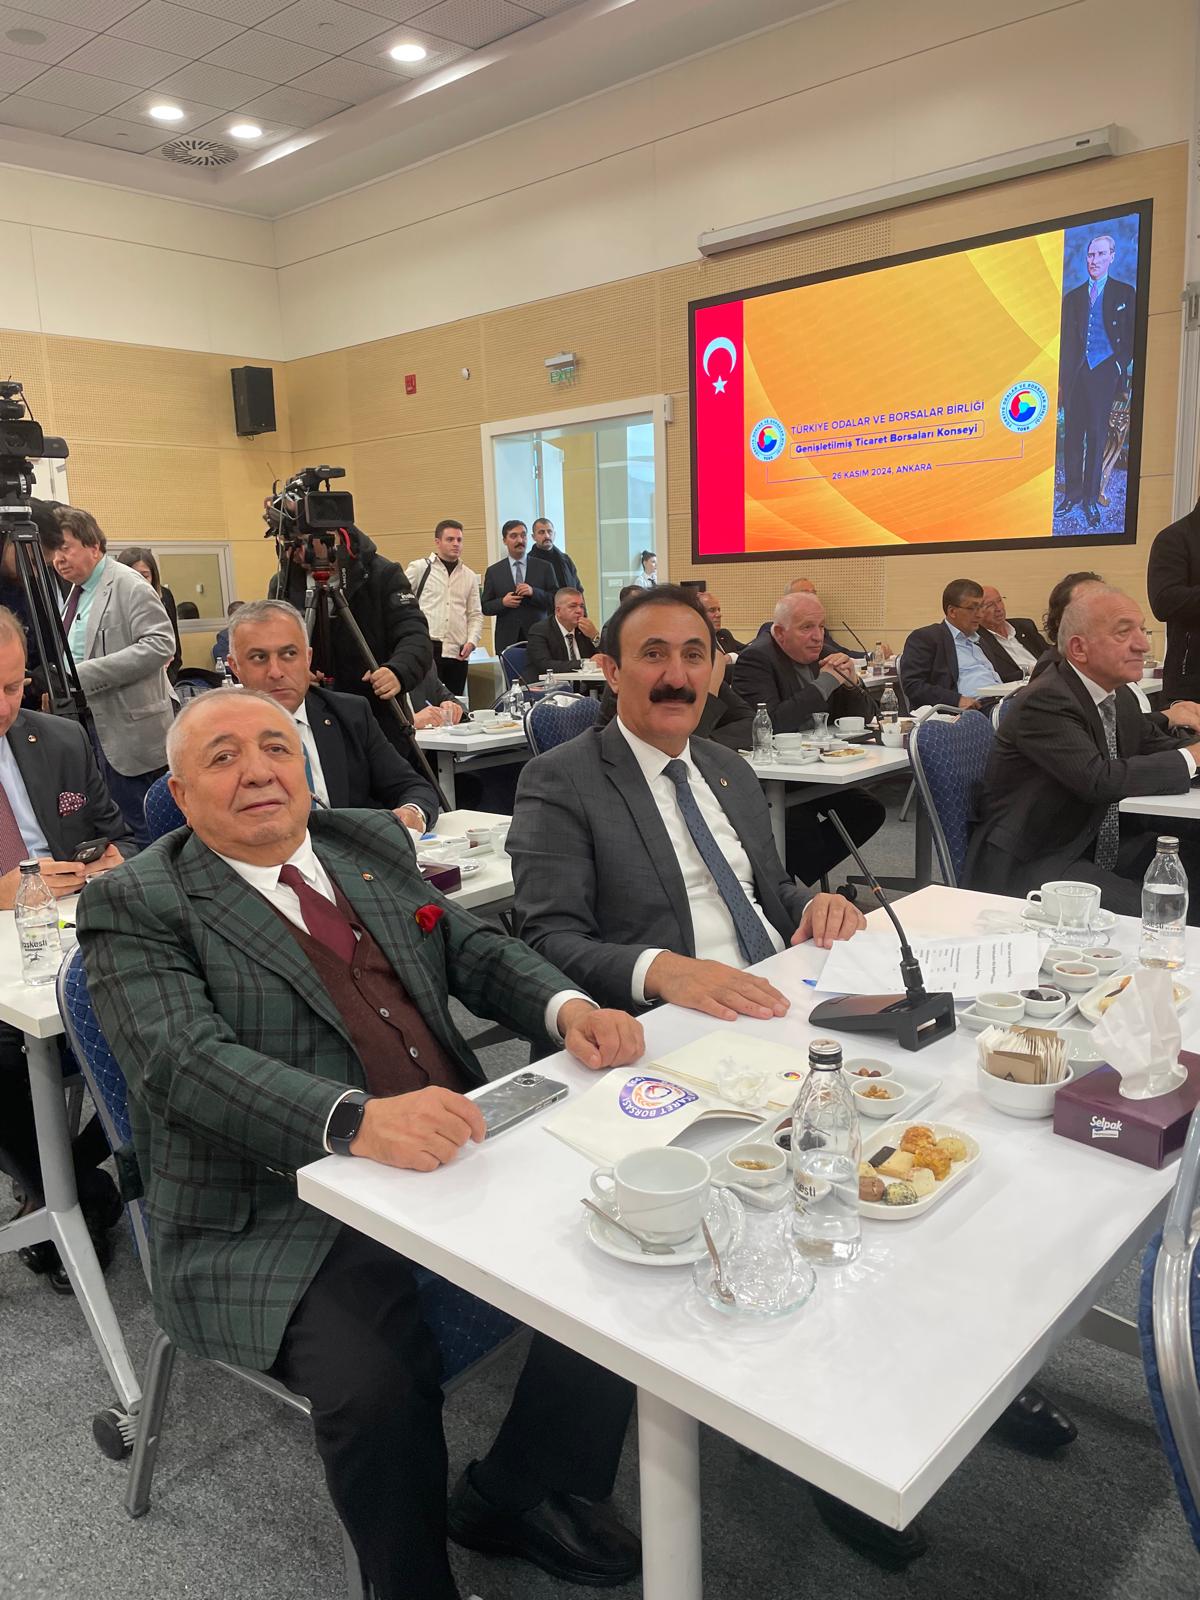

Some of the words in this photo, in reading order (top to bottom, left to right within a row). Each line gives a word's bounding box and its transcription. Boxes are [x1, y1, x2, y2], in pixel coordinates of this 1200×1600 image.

[831, 416, 870, 430] ODALAR
[873, 415, 886, 424] VE
[889, 407, 944, 422] BORSALAR
[946, 400, 985, 415] BİRLİĞİ
[795, 440, 853, 454] Genişletilmiş
[855, 435, 888, 446] Ticaret
[890, 430, 934, 443] Borsaları
[937, 423, 978, 437] Konseyi
[832, 472, 842, 480] 26
[844, 468, 870, 479] KASIM
[871, 466, 894, 476] 2024,
[896, 463, 932, 474] ANKARA
[1089, 1115, 1123, 1131] Selpak
